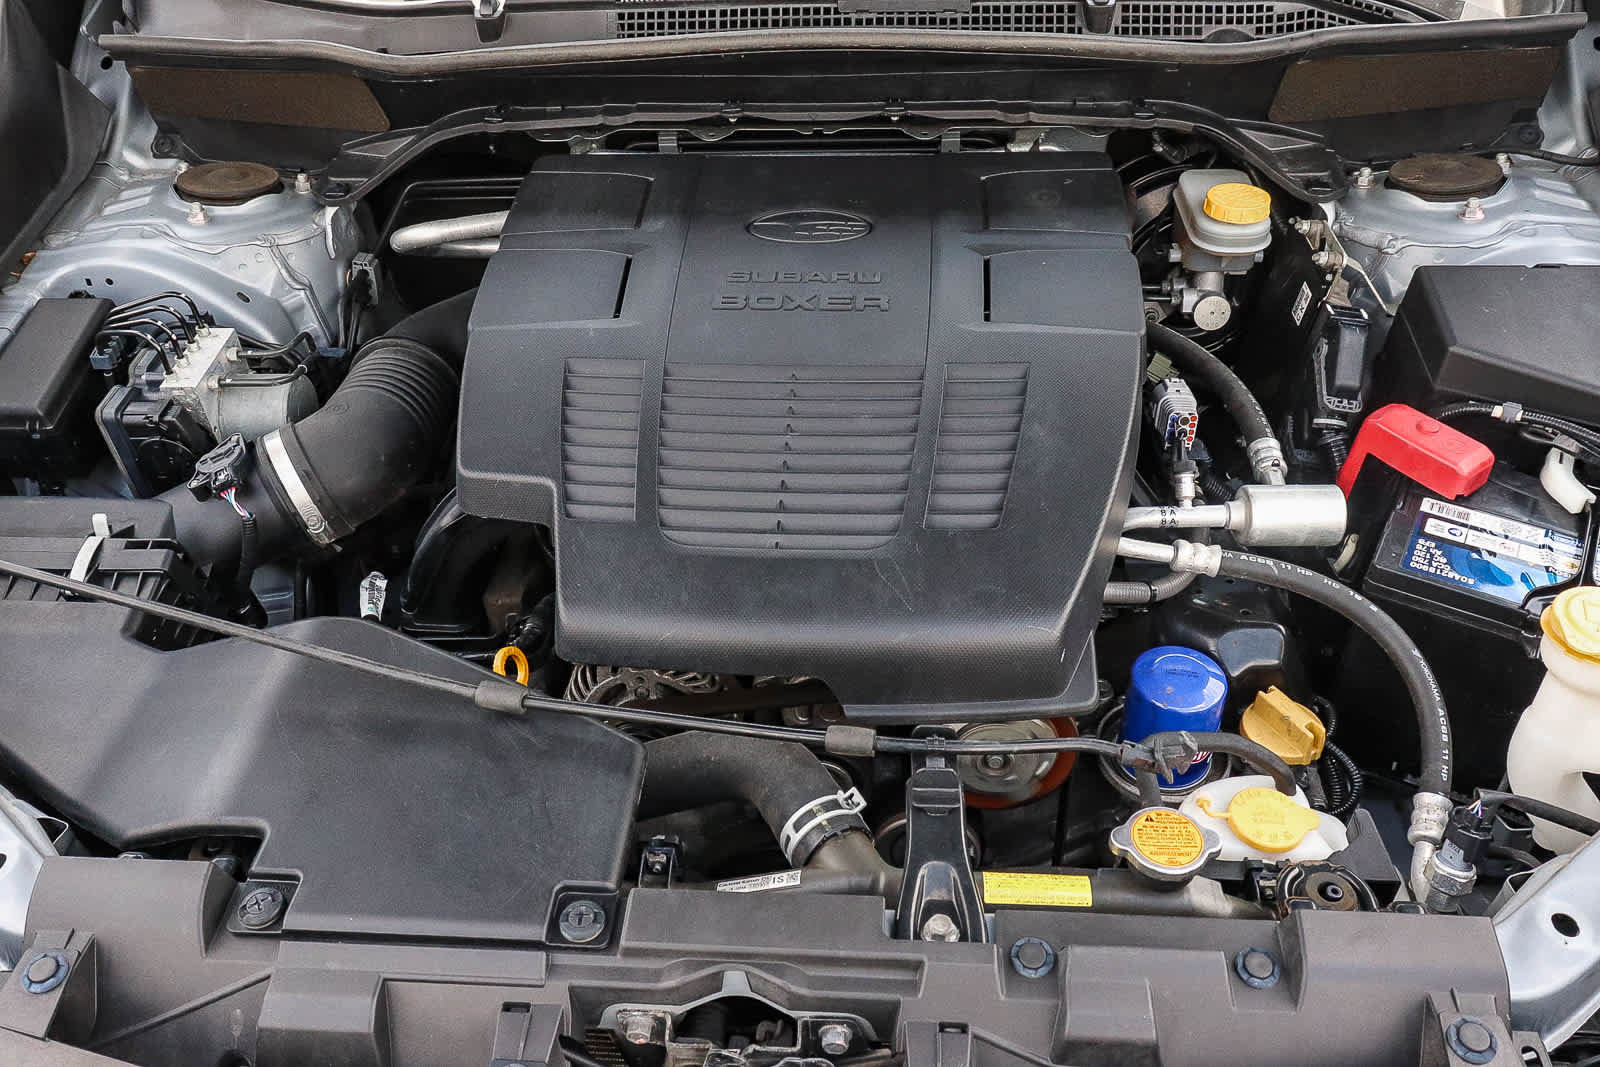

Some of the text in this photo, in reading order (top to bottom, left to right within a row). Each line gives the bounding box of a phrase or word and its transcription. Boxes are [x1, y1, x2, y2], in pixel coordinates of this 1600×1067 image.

[728, 271, 881, 284] SUBARU
[711, 293, 889, 312] BOXER
[1432, 561, 1450, 570] CCA
[1419, 659, 1441, 702] YOKOHAMA
[1441, 765, 1449, 782] HP
